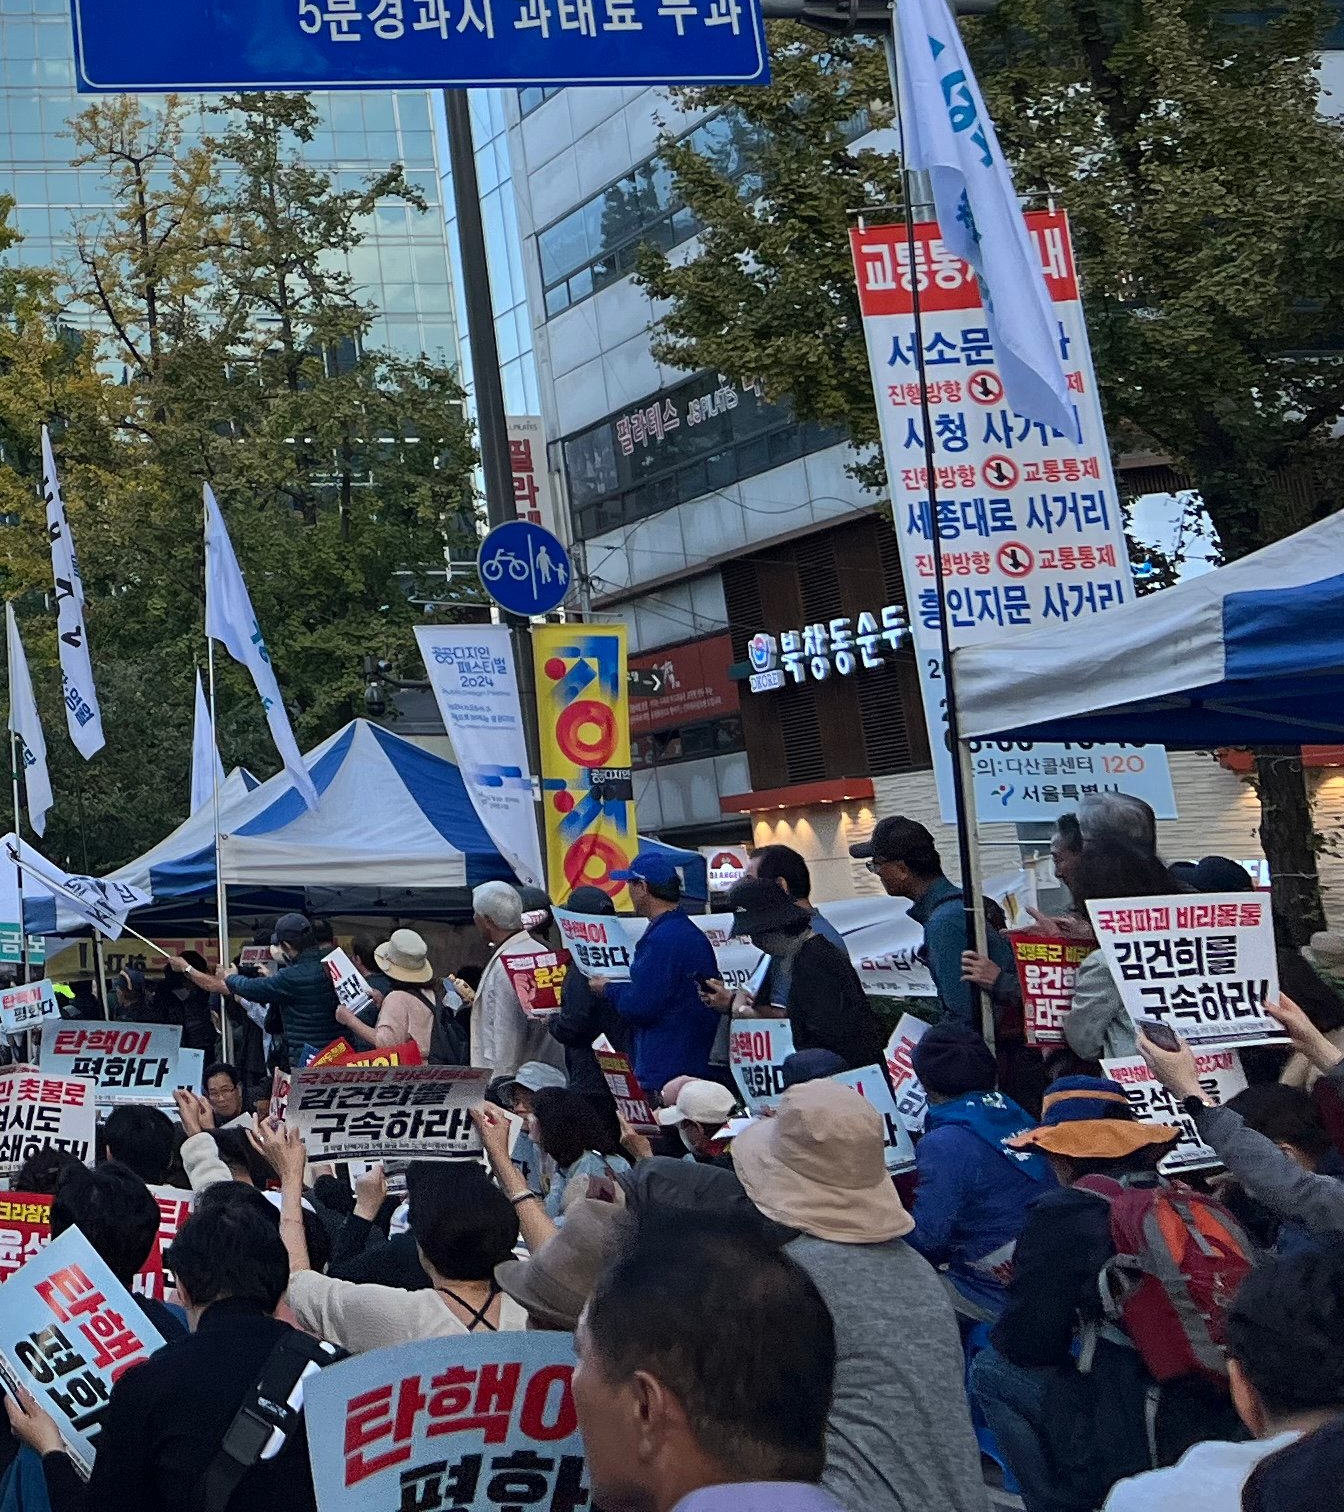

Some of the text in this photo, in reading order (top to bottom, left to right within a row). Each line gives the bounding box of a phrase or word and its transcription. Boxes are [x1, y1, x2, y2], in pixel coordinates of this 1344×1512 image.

[861, 238, 976, 293] 교통통
[615, 397, 678, 456] 필라테스
[1023, 455, 1101, 483] 교통통제
[906, 490, 1111, 540] 세종대로 사거리
[1038, 543, 1117, 571] 교통통제
[1042, 579, 1124, 622] 사거리
[780, 604, 912, 685] 북창동순두
[457, 656, 508, 675] 페스티벌
[460, 675, 494, 688] 2024
[1100, 754, 1145, 773] 120
[560, 917, 609, 945] 탄핵이
[1097, 907, 1170, 934] 국정파괴
[574, 942, 631, 969] 평화다
[1113, 935, 1237, 981] 김건희를
[1, 986, 42, 1010] 탄핵이
[13, 998, 54, 1022] 평화다
[52, 1029, 152, 1056] 탄핵이
[70, 1056, 170, 1088] 평화다
[18, 1078, 87, 1107] 촛불로
[297, 1082, 454, 1111] 김건희를
[310, 1107, 472, 1143] 구속하라!
